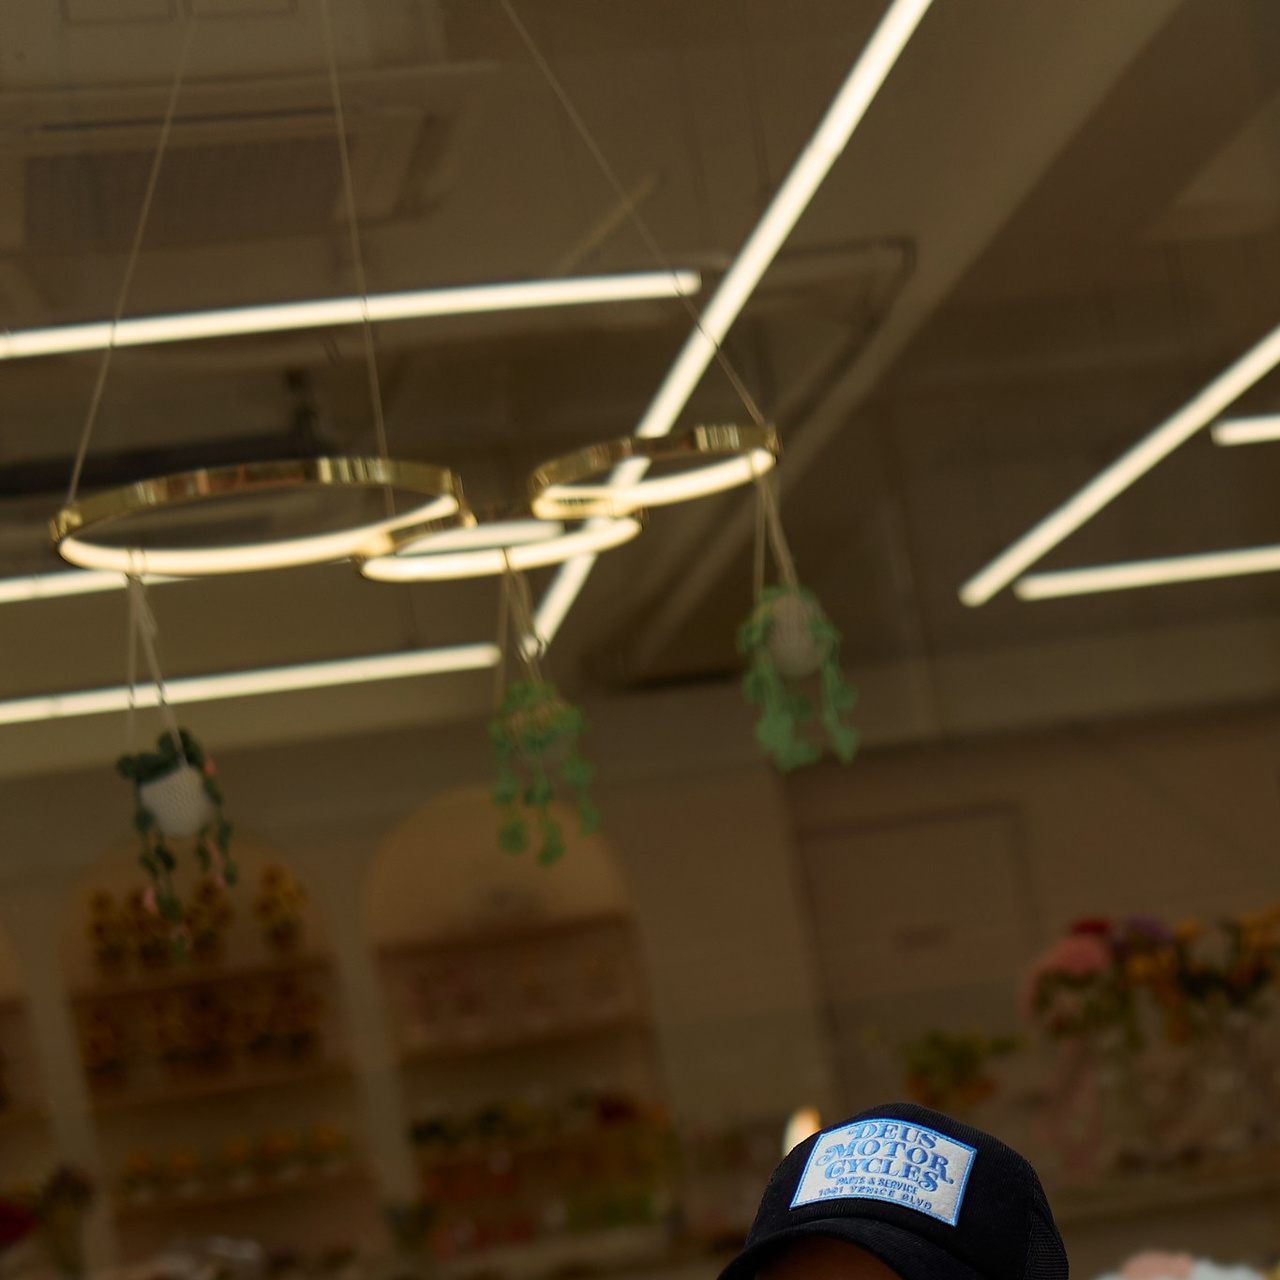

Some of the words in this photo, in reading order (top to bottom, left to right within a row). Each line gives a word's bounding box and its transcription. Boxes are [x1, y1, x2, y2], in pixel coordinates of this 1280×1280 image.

[846, 1122, 938, 1149] DEUS
[815, 1139, 954, 1184] MOTOR
[825, 1157, 939, 1192] CYCLES
[835, 1176, 865, 1185] PARTS
[868, 1177, 876, 1185] &
[877, 1178, 919, 1194] SERVICE
[850, 1185, 896, 1197] VENICE
[901, 1192, 933, 1210] BLVD
